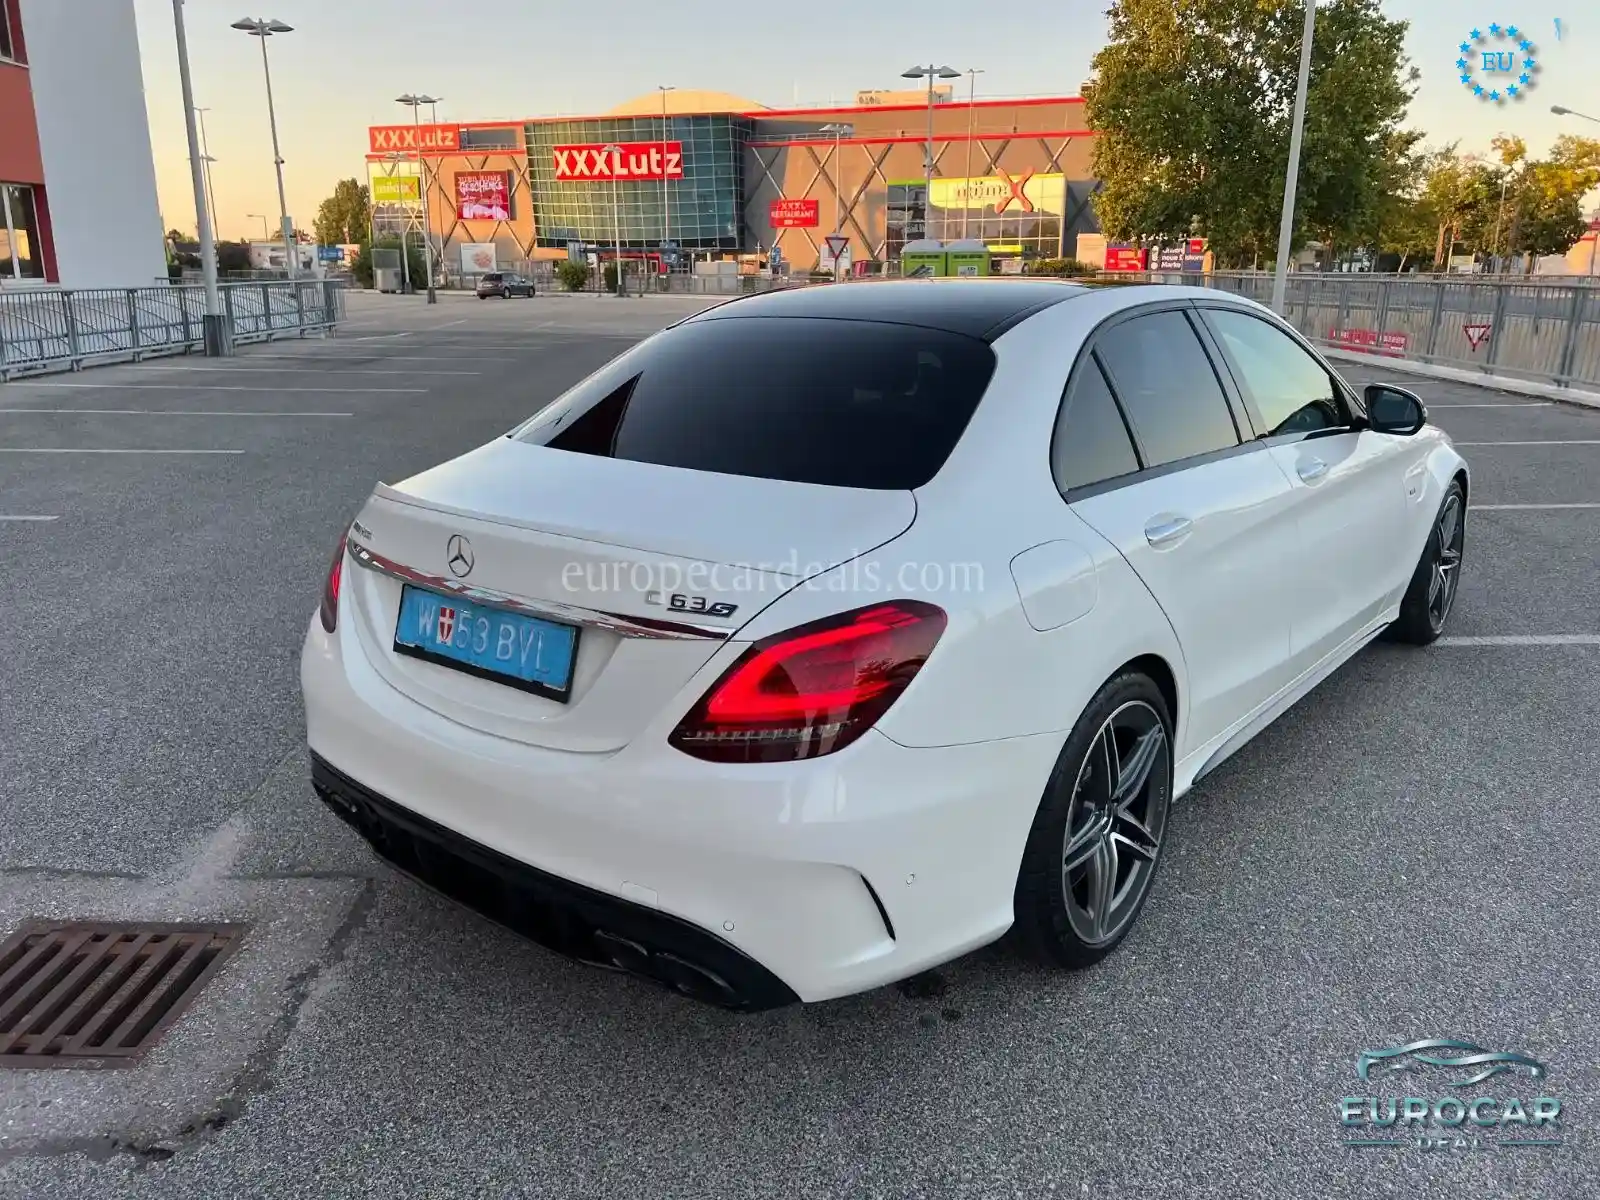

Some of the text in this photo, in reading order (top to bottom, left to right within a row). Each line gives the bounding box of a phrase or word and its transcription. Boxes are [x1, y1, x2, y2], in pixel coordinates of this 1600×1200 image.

[373, 128, 454, 149] XXXLutz
[553, 148, 682, 177] XXXLutz
[418, 600, 550, 674] W 53 BVL
